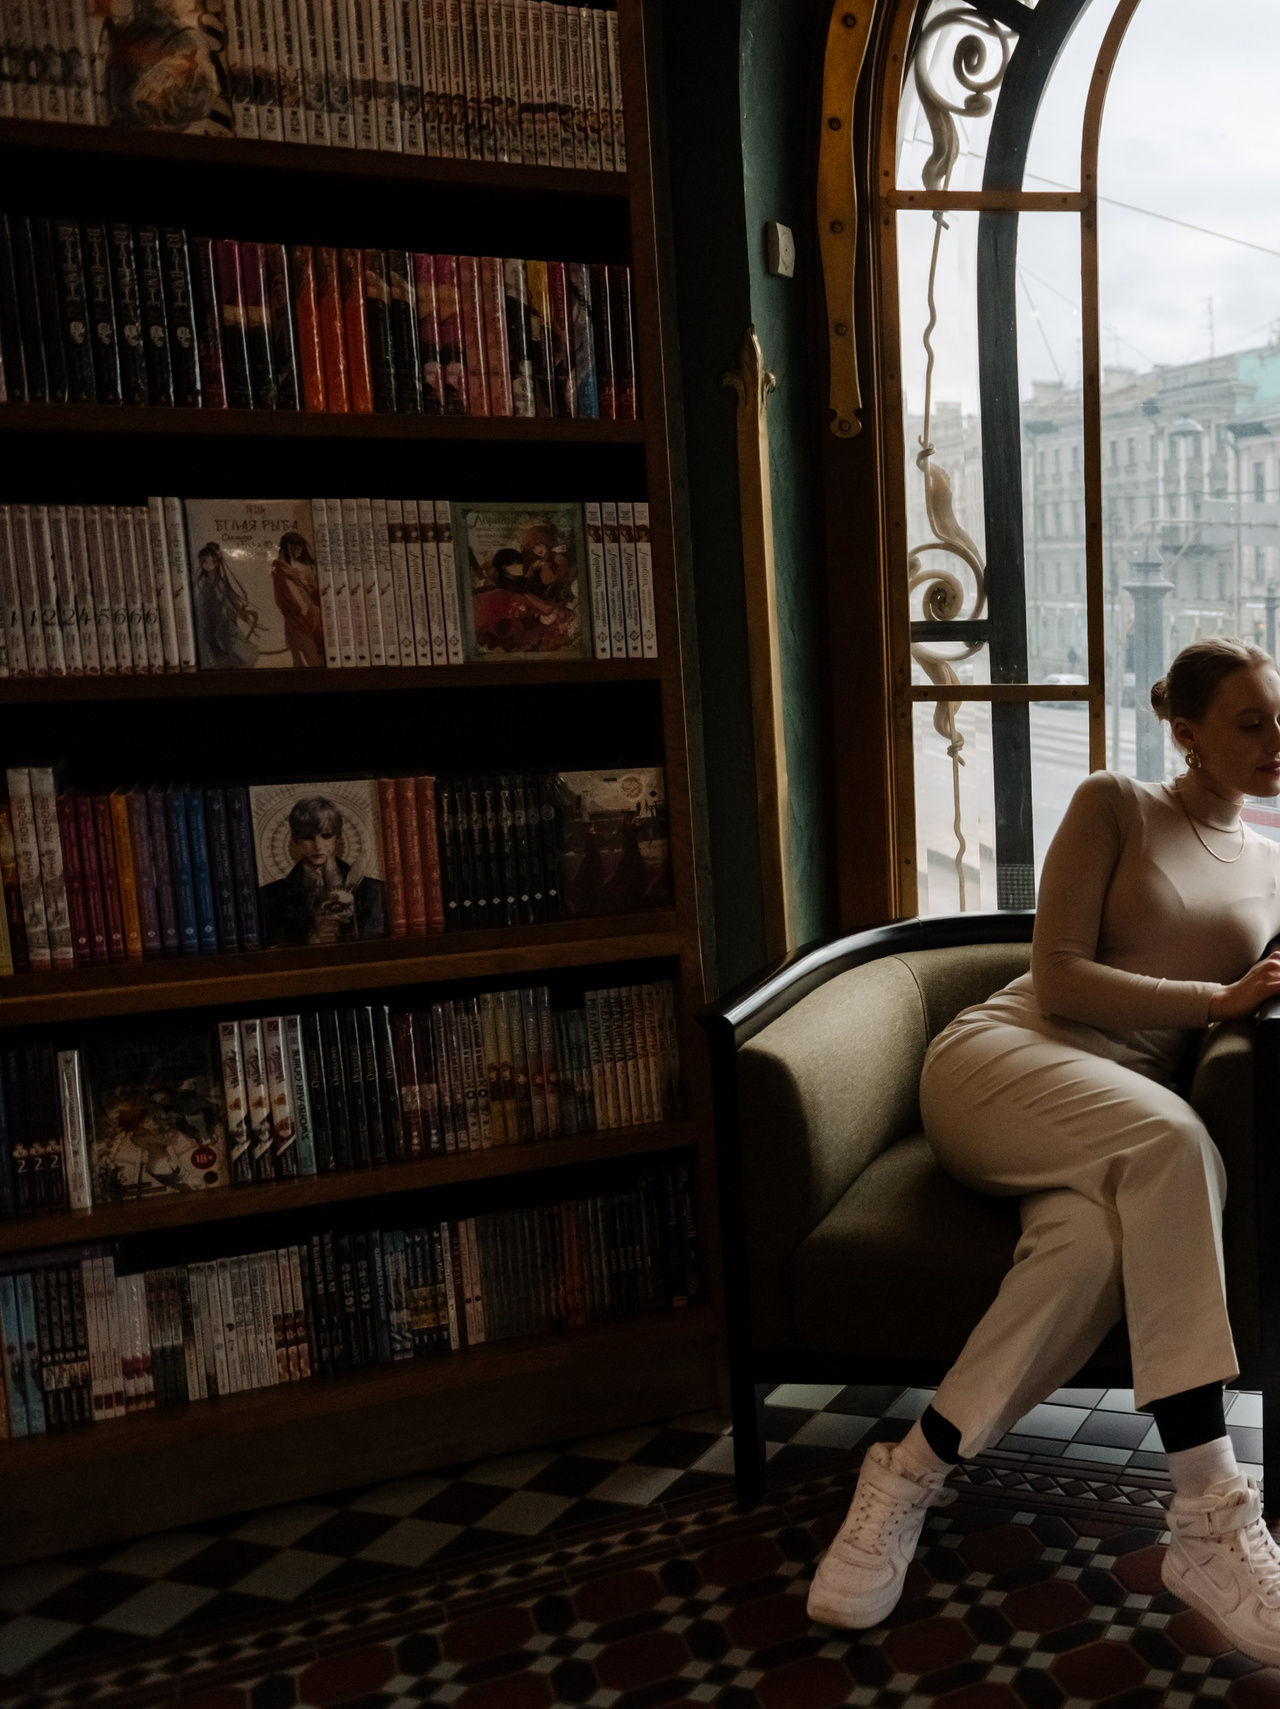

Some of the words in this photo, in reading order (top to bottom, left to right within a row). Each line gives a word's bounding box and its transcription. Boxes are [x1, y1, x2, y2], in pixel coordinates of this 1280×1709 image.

[262, 520, 298, 532] РЫБА
[42, 609, 56, 626] 2
[61, 609, 75, 626] 2
[80, 608, 91, 625] 4
[98, 608, 110, 625] 5
[114, 608, 126, 625] 6
[130, 608, 142, 625] 6
[146, 608, 157, 625] 6
[298, 1103, 309, 1141] SWORD
[17, 1159, 28, 1174] 2
[34, 1157, 44, 1171] 2
[50, 1155, 60, 1169] 2
[194, 1153, 214, 1163] 18+
